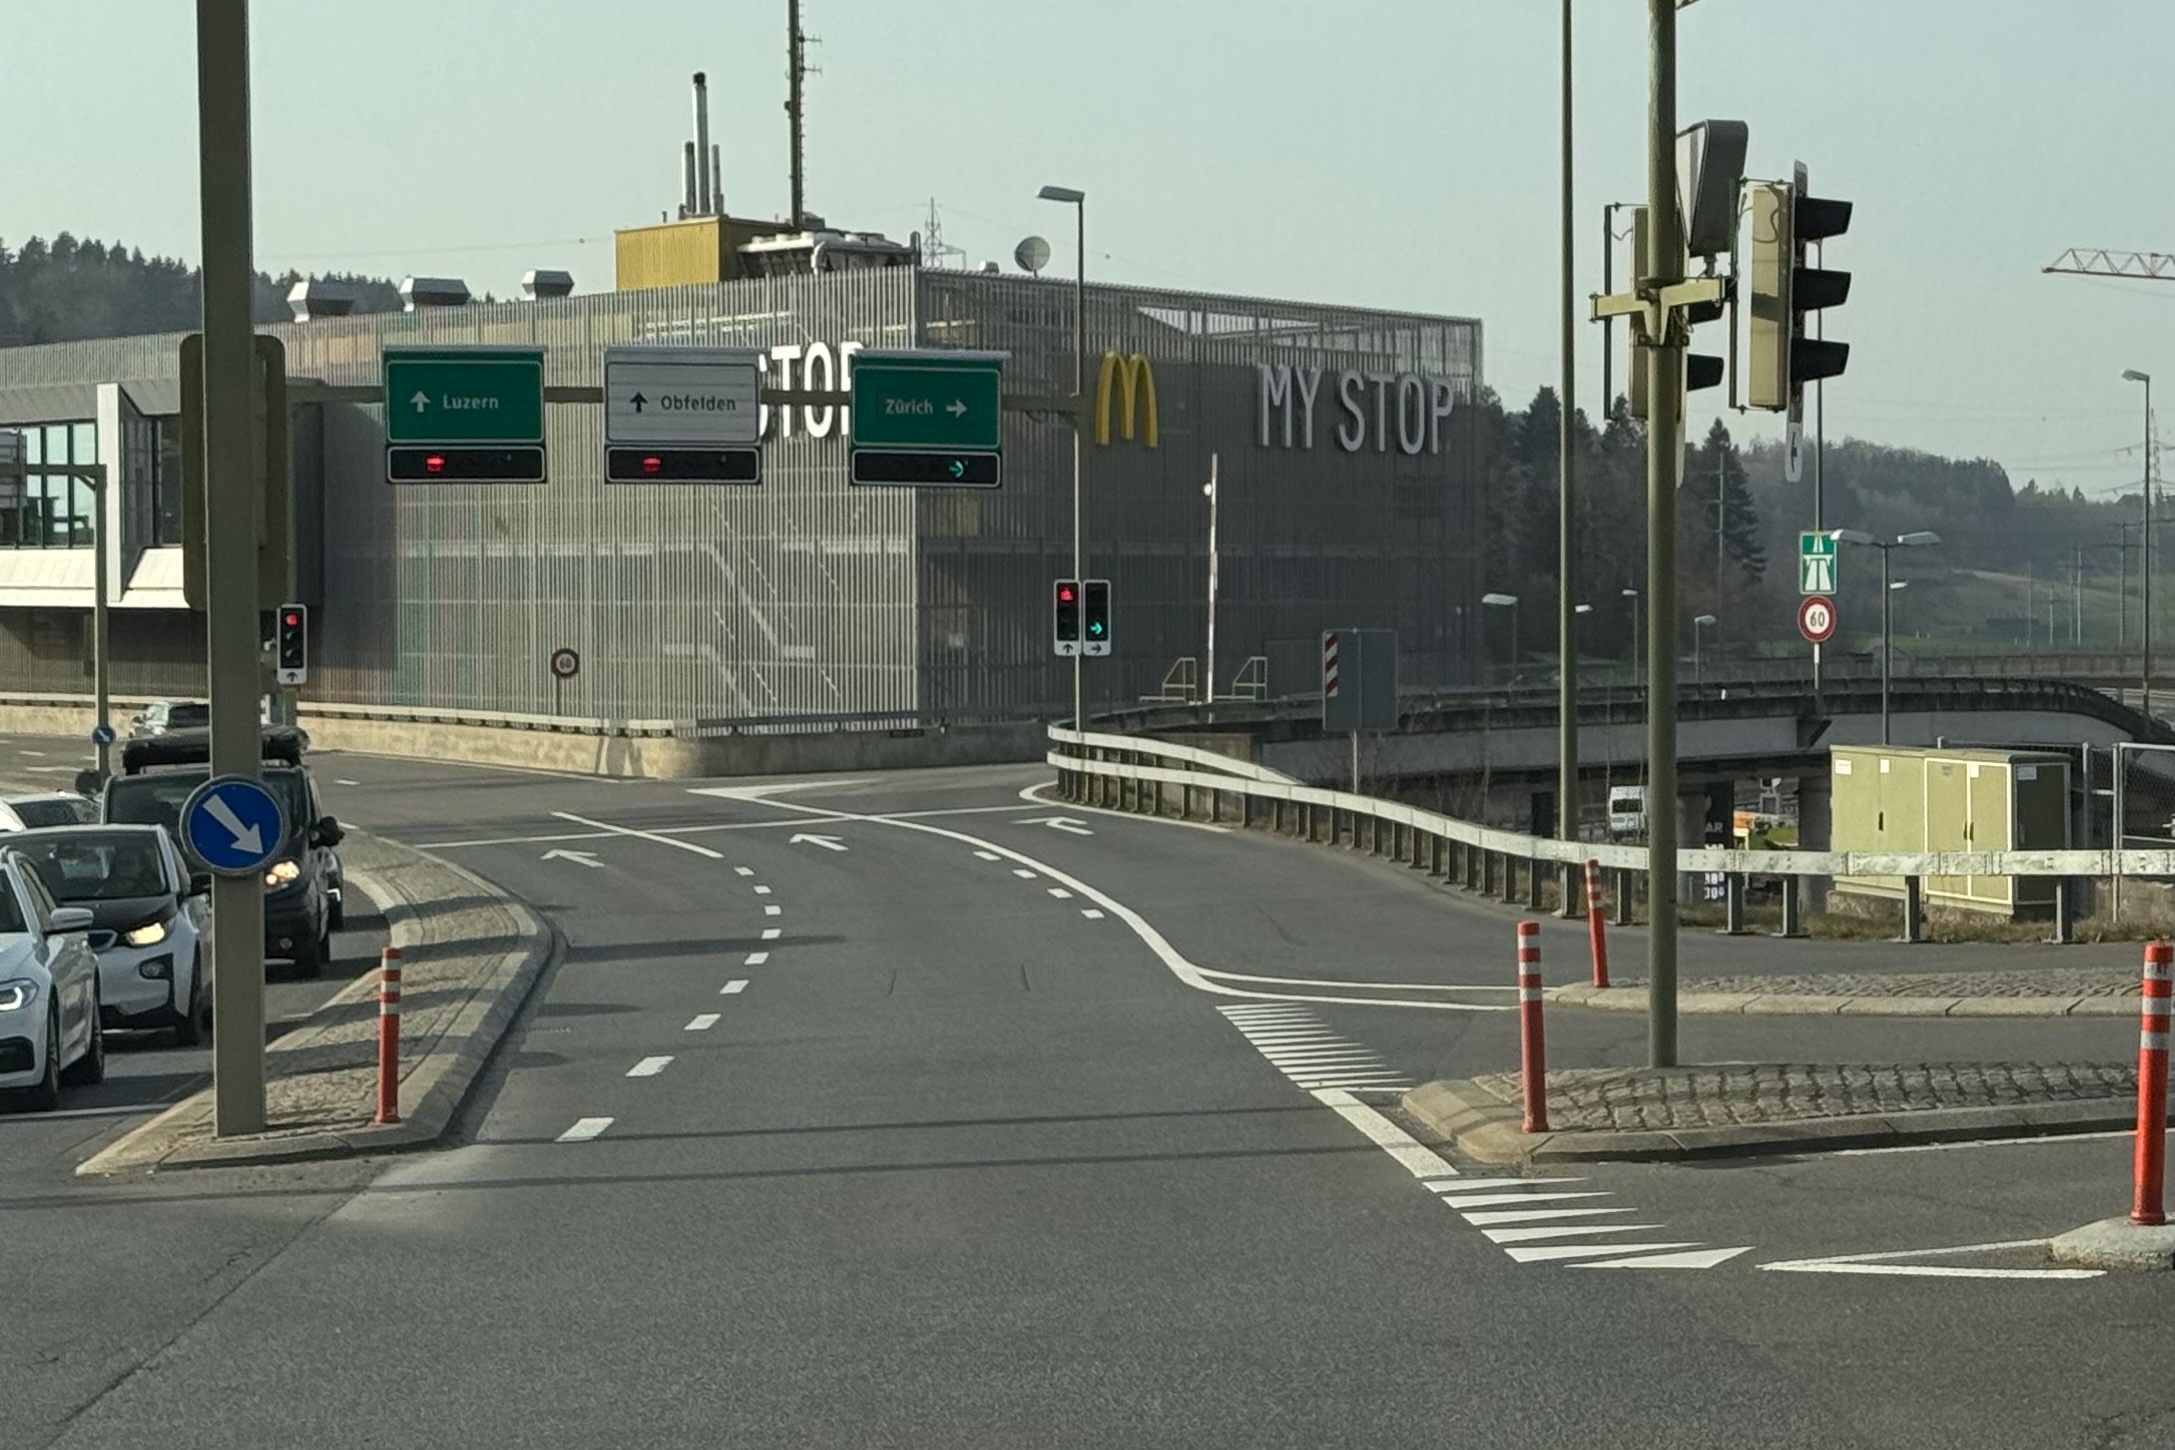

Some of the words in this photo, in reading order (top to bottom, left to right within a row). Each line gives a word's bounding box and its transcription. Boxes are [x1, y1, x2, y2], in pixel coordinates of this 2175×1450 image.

[443, 393, 498, 410] Luzern
[661, 394, 736, 411] Obfelden
[886, 397, 933, 415] Zürich
[1258, 363, 1322, 448] MY
[1339, 369, 1454, 455] STOP
[1810, 611, 1825, 627] 60
